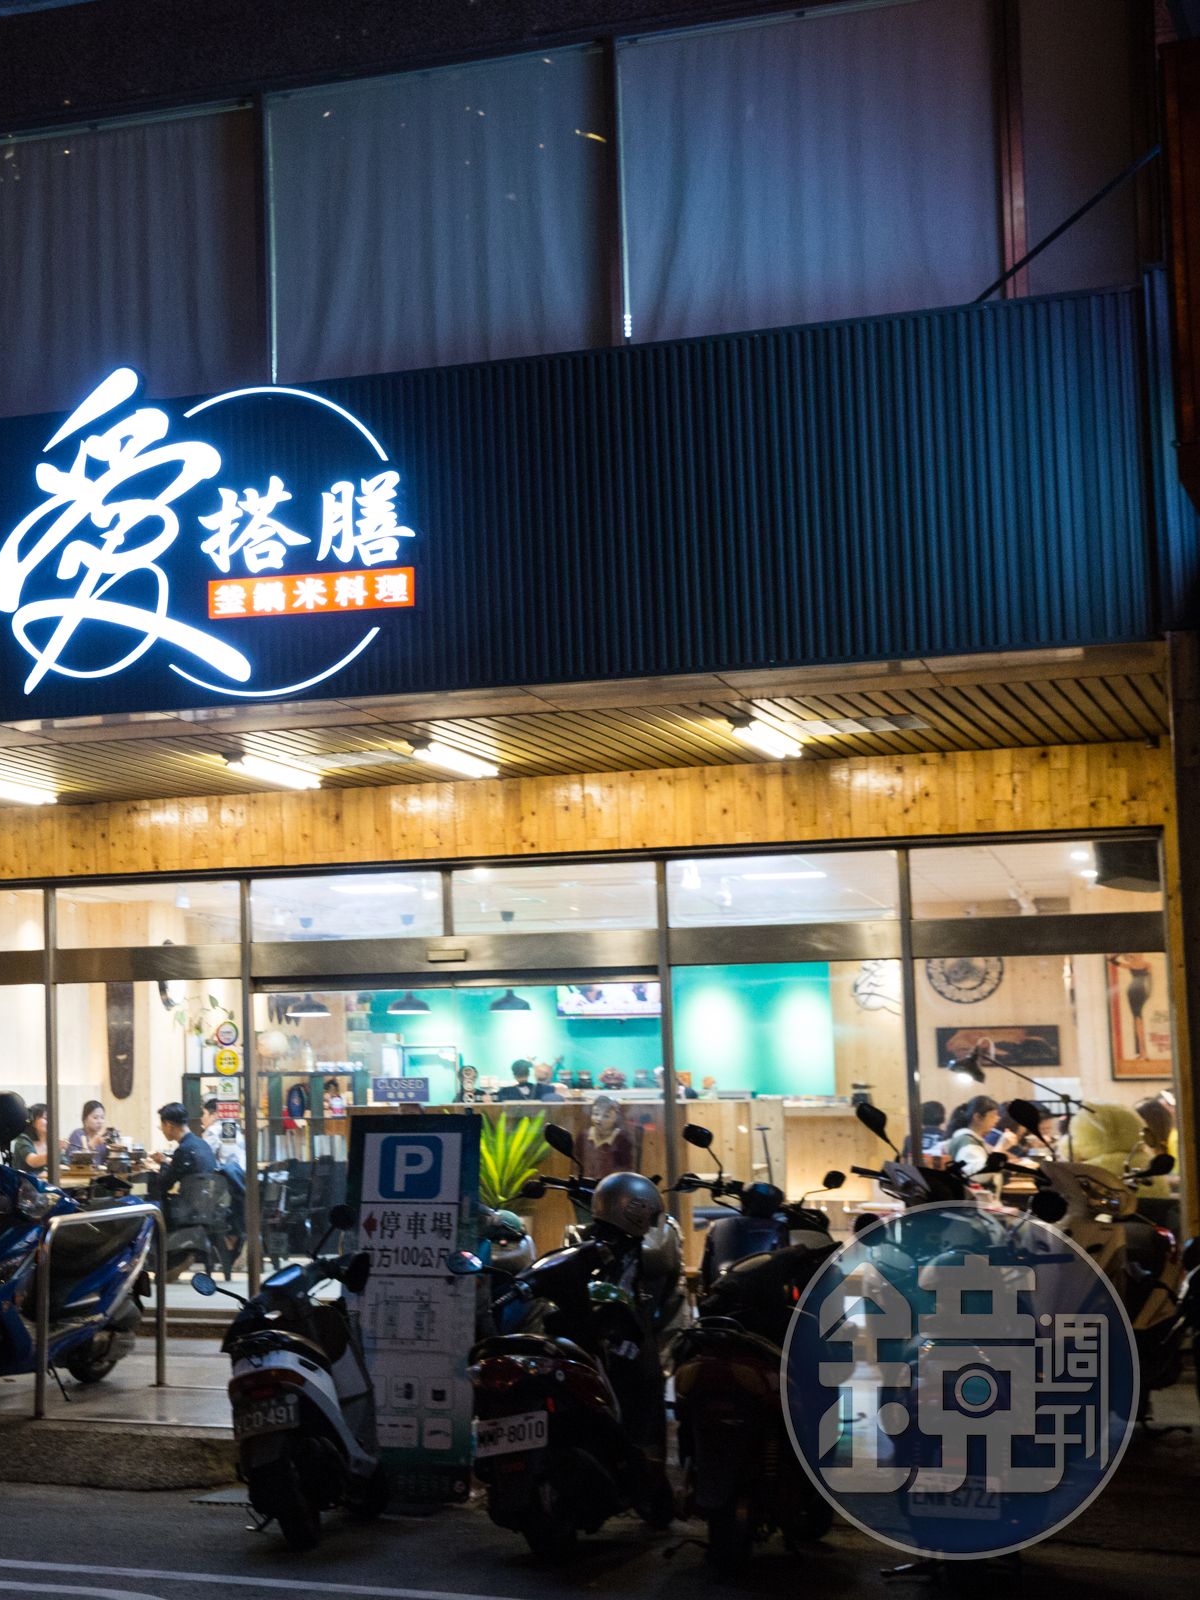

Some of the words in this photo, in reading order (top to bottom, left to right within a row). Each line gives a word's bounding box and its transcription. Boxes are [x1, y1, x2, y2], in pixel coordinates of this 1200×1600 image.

[376, 1079, 425, 1090] CLOSED
[393, 1144, 434, 1193] P
[379, 1210, 454, 1240] 停車場
